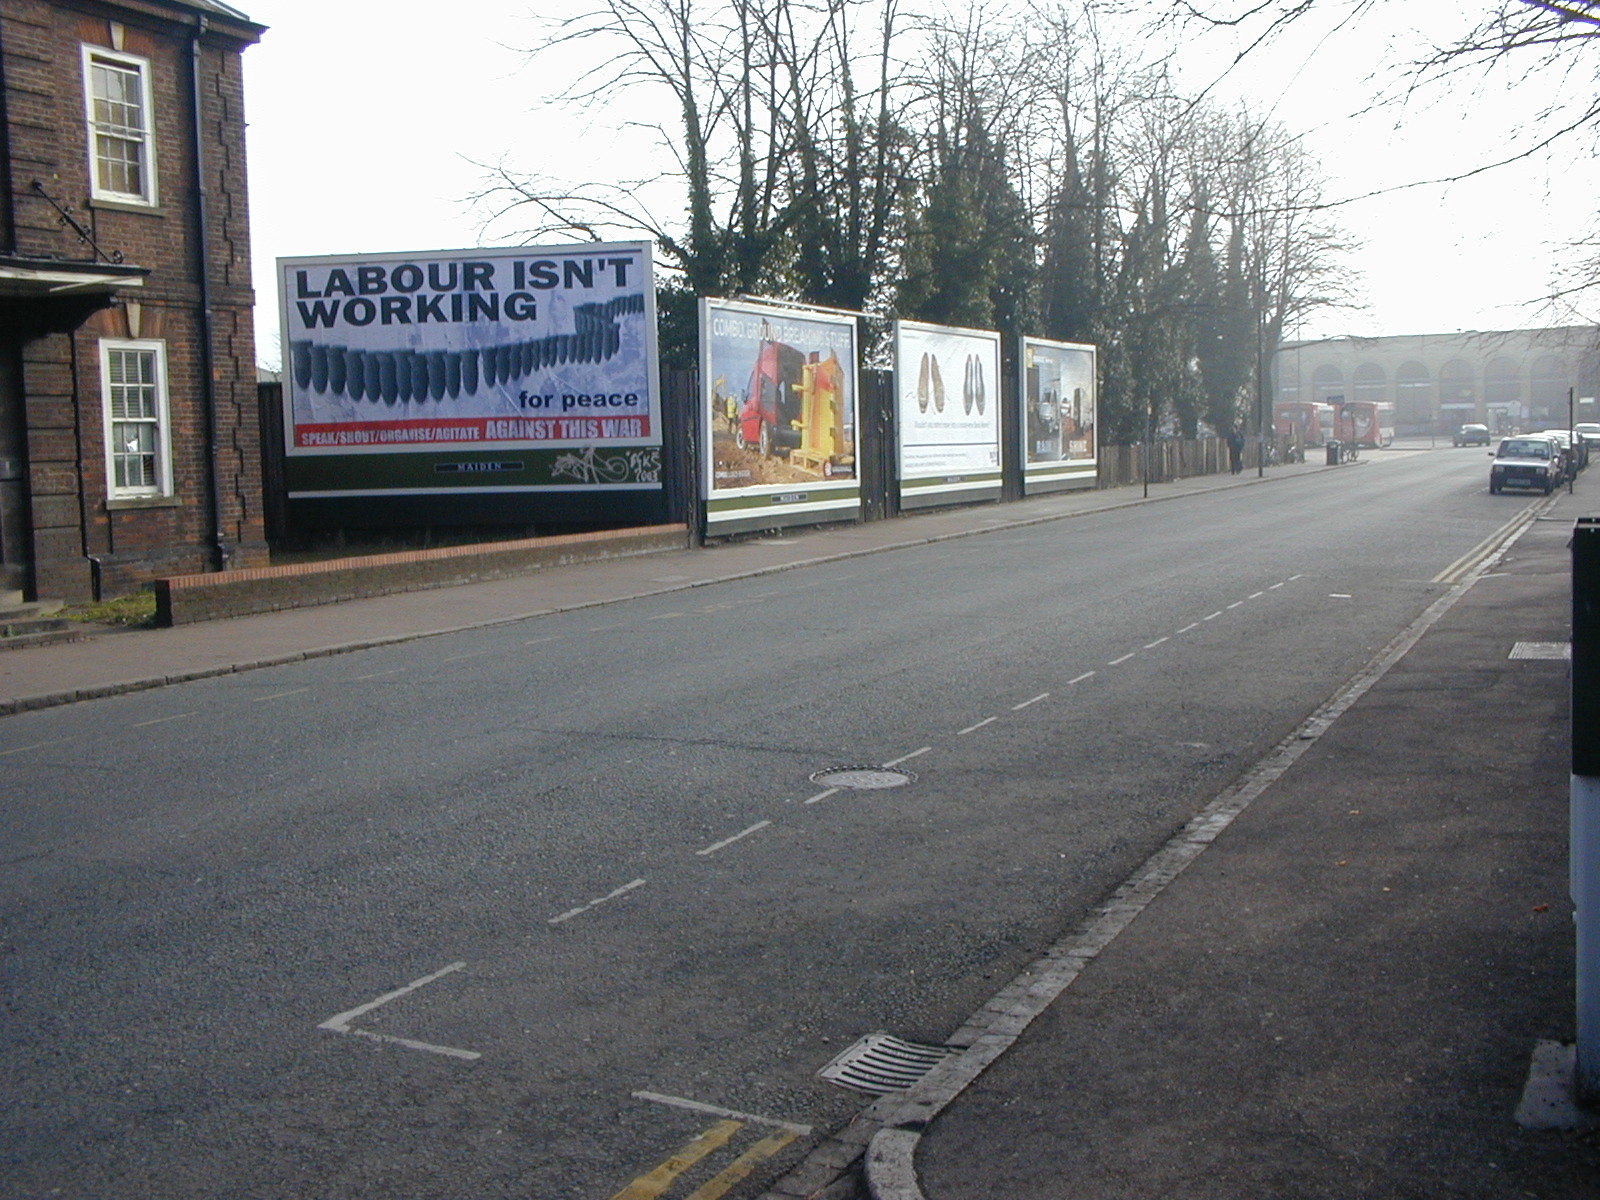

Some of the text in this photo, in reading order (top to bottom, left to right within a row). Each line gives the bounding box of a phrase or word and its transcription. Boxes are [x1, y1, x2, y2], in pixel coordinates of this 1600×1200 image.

[296, 258, 633, 298] LABOUR ISN'T
[296, 292, 537, 329] WORKING
[519, 391, 638, 412] for peace
[485, 419, 556, 439] AGAINST
[559, 419, 599, 438] THIS
[602, 418, 642, 437] WAR
[458, 462, 501, 471] MAIDEN
